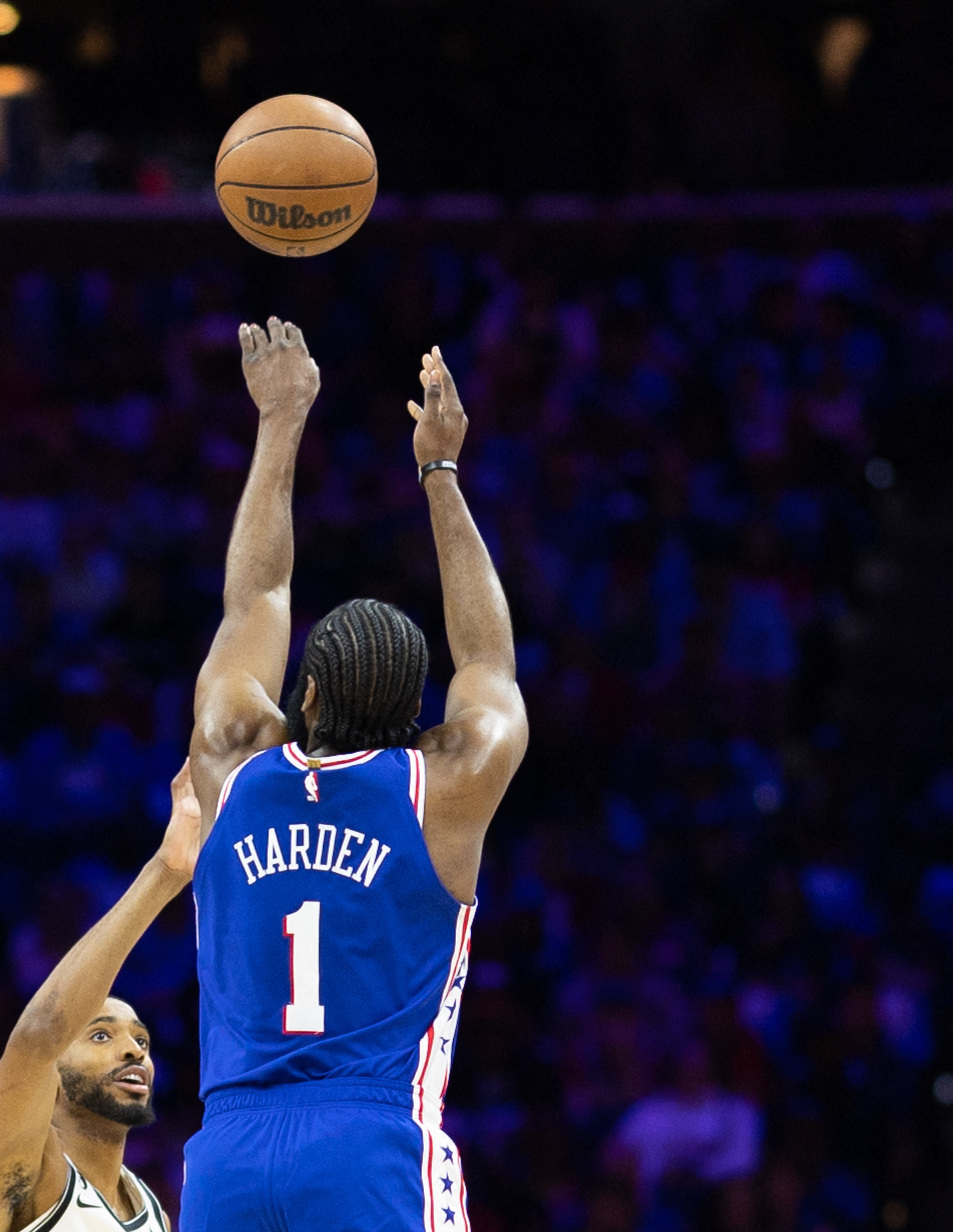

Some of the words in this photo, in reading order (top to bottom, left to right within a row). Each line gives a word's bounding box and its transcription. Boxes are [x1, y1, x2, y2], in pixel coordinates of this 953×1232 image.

[246, 196, 352, 230] Wilson
[234, 824, 391, 888] HARDEN
[282, 901, 325, 1035] 1
